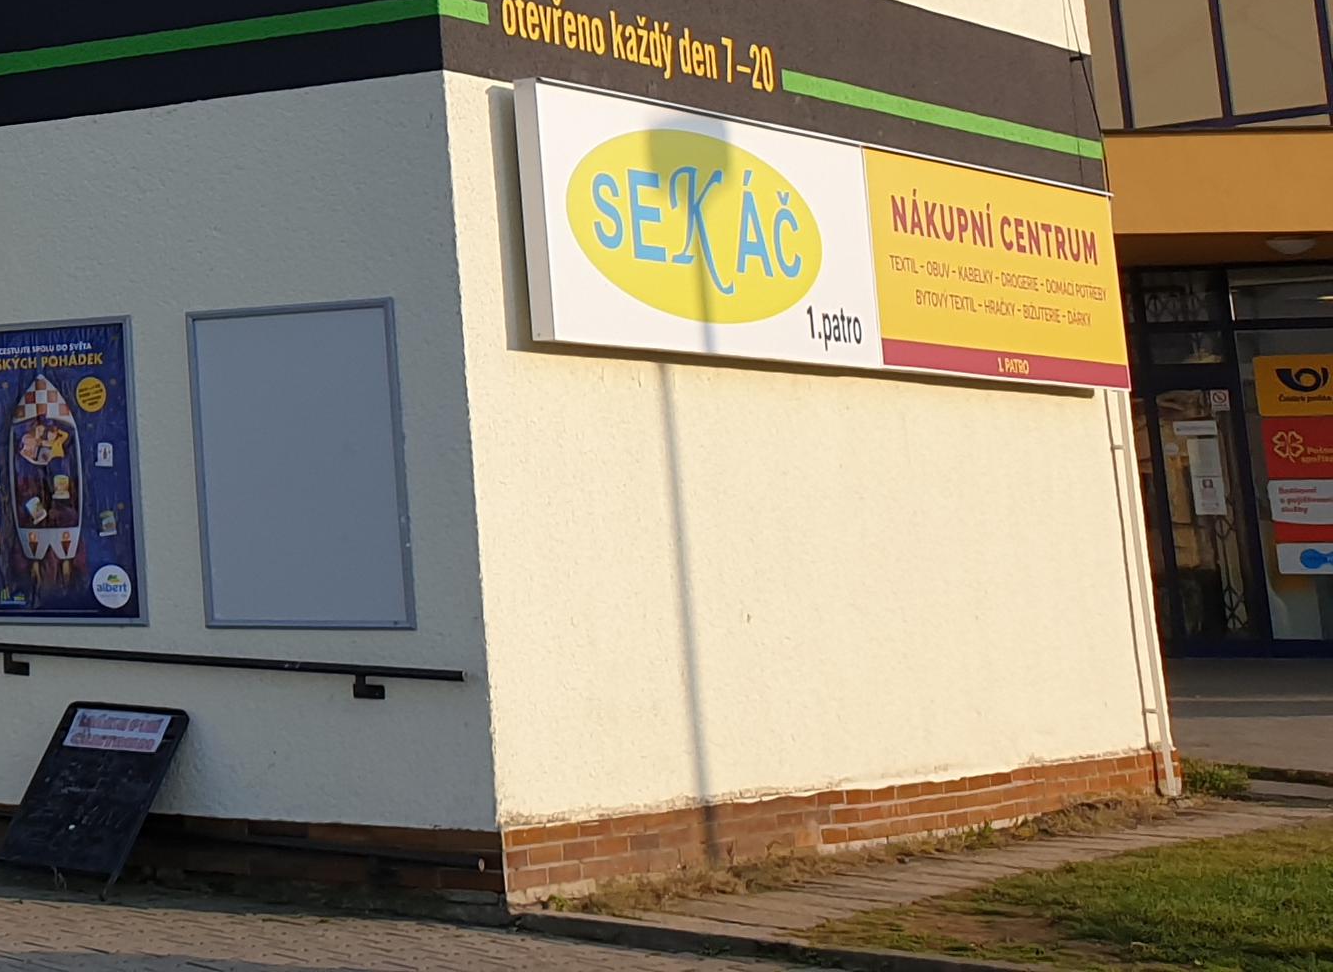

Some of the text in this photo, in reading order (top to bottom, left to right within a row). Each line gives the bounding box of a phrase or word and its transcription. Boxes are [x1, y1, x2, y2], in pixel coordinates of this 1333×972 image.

[609, 10, 673, 80] každý
[678, 28, 718, 80] den
[592, 165, 803, 296] SEKÁČ
[890, 188, 1099, 266] NÁKUPNÍ CENTRUM
[889, 255, 919, 274] TEXTIL
[926, 260, 950, 279] OBUV
[958, 266, 994, 285] KABELKY
[1001, 272, 1039, 292] DROGERIE
[915, 289, 948, 309] BYTOVÝ
[949, 294, 978, 313] TEXTIL
[41, 350, 103, 368] POHÁDEK
[55, 343, 68, 352] DO
[1005, 357, 1030, 375] PATRO
[96, 583, 127, 593] albert
